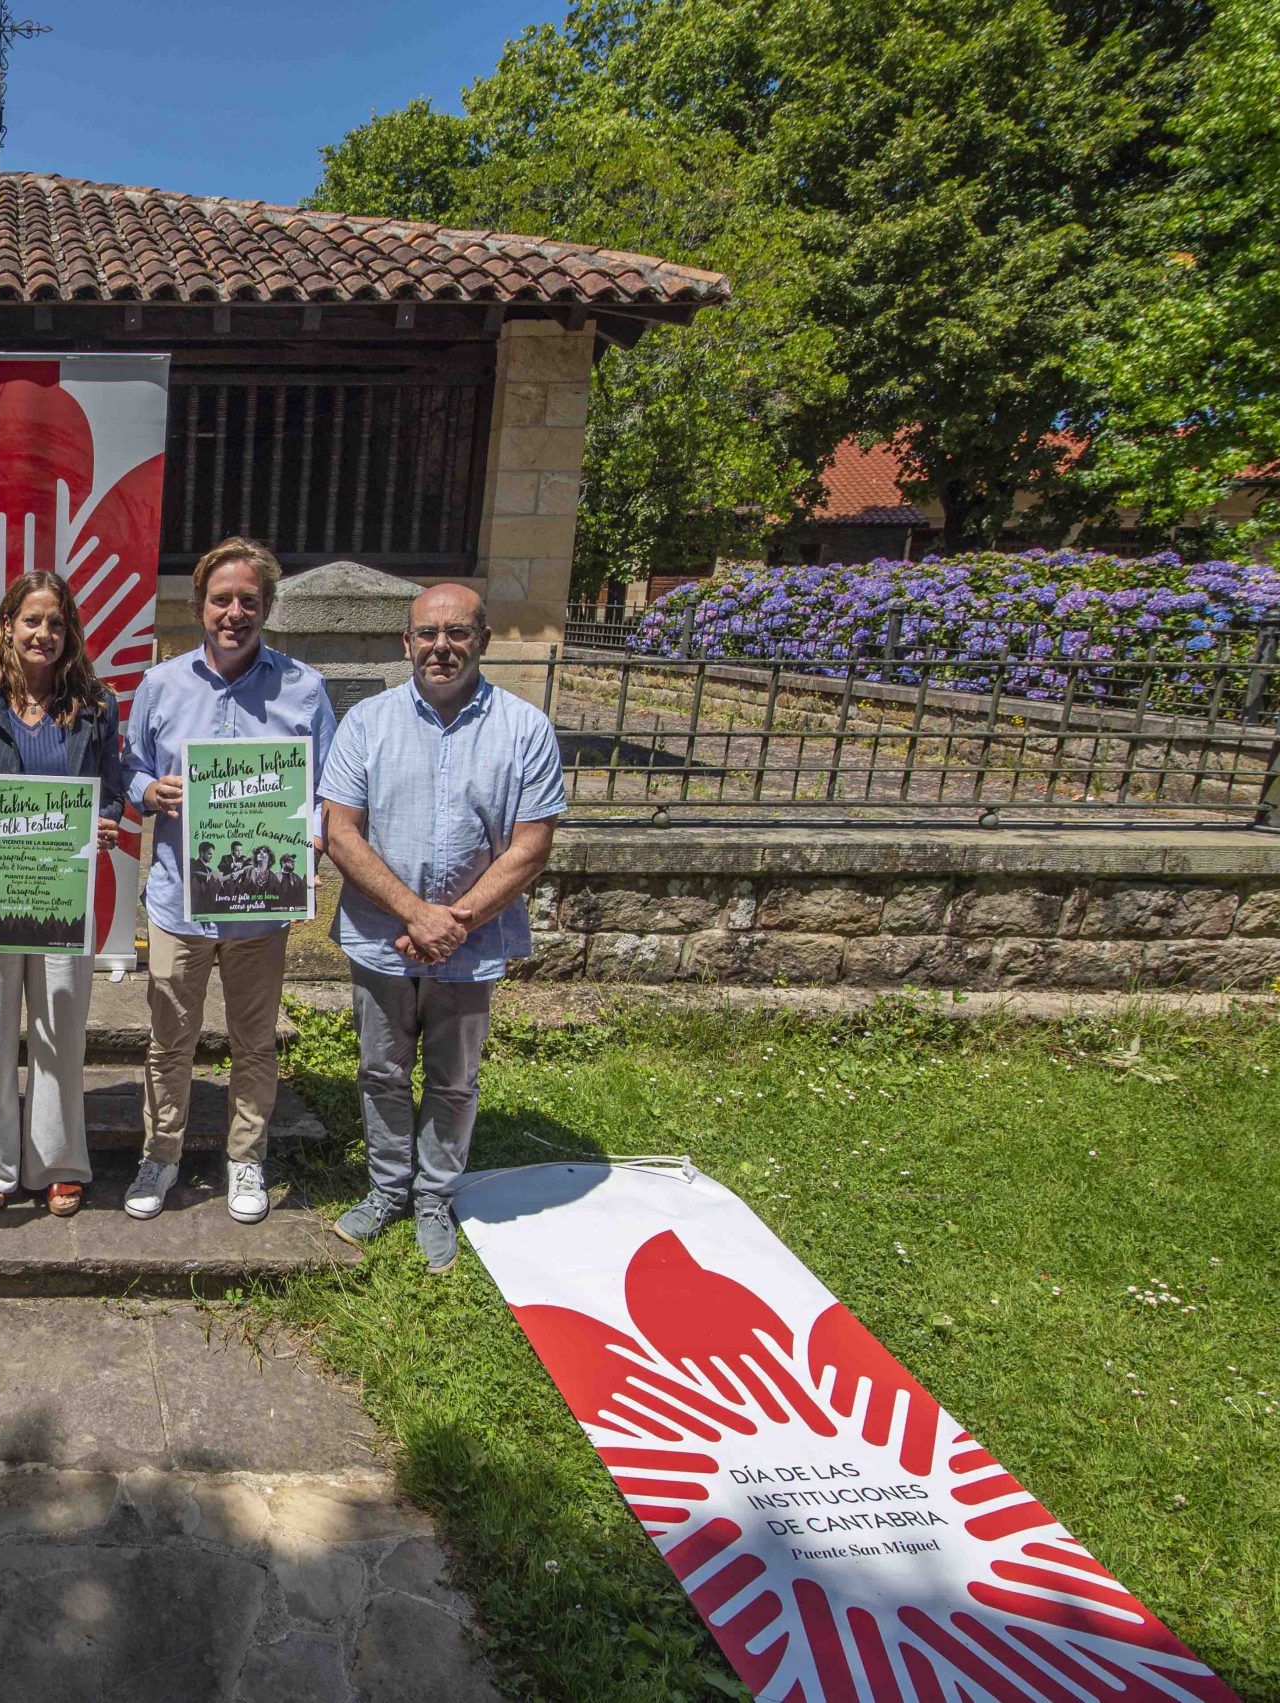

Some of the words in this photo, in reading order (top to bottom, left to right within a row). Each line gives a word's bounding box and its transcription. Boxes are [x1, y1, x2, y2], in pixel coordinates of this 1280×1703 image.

[258, 747, 307, 775] Infinita
[210, 781, 237, 799] Folk
[239, 774, 285, 795] Festival
[45, 787, 93, 815] Infinita
[24, 812, 70, 832] Festival
[199, 819, 223, 829] Arthur
[224, 818, 245, 829] Coates
[201, 831, 225, 839] Kerran
[227, 829, 255, 839] Cotterell
[255, 821, 313, 849] Casapalma
[6, 884, 50, 896] Casapalma
[729, 1465, 775, 1484] DÍA
[774, 1465, 811, 1482] DE
[811, 1463, 861, 1480] LAS
[747, 1484, 929, 1510] INSTITUCIONES
[766, 1518, 805, 1536] DE
[806, 1510, 949, 1533] CANTABRIA
[790, 1545, 848, 1561] Puente
[849, 1543, 881, 1557] San
[881, 1538, 942, 1558] Miguel
